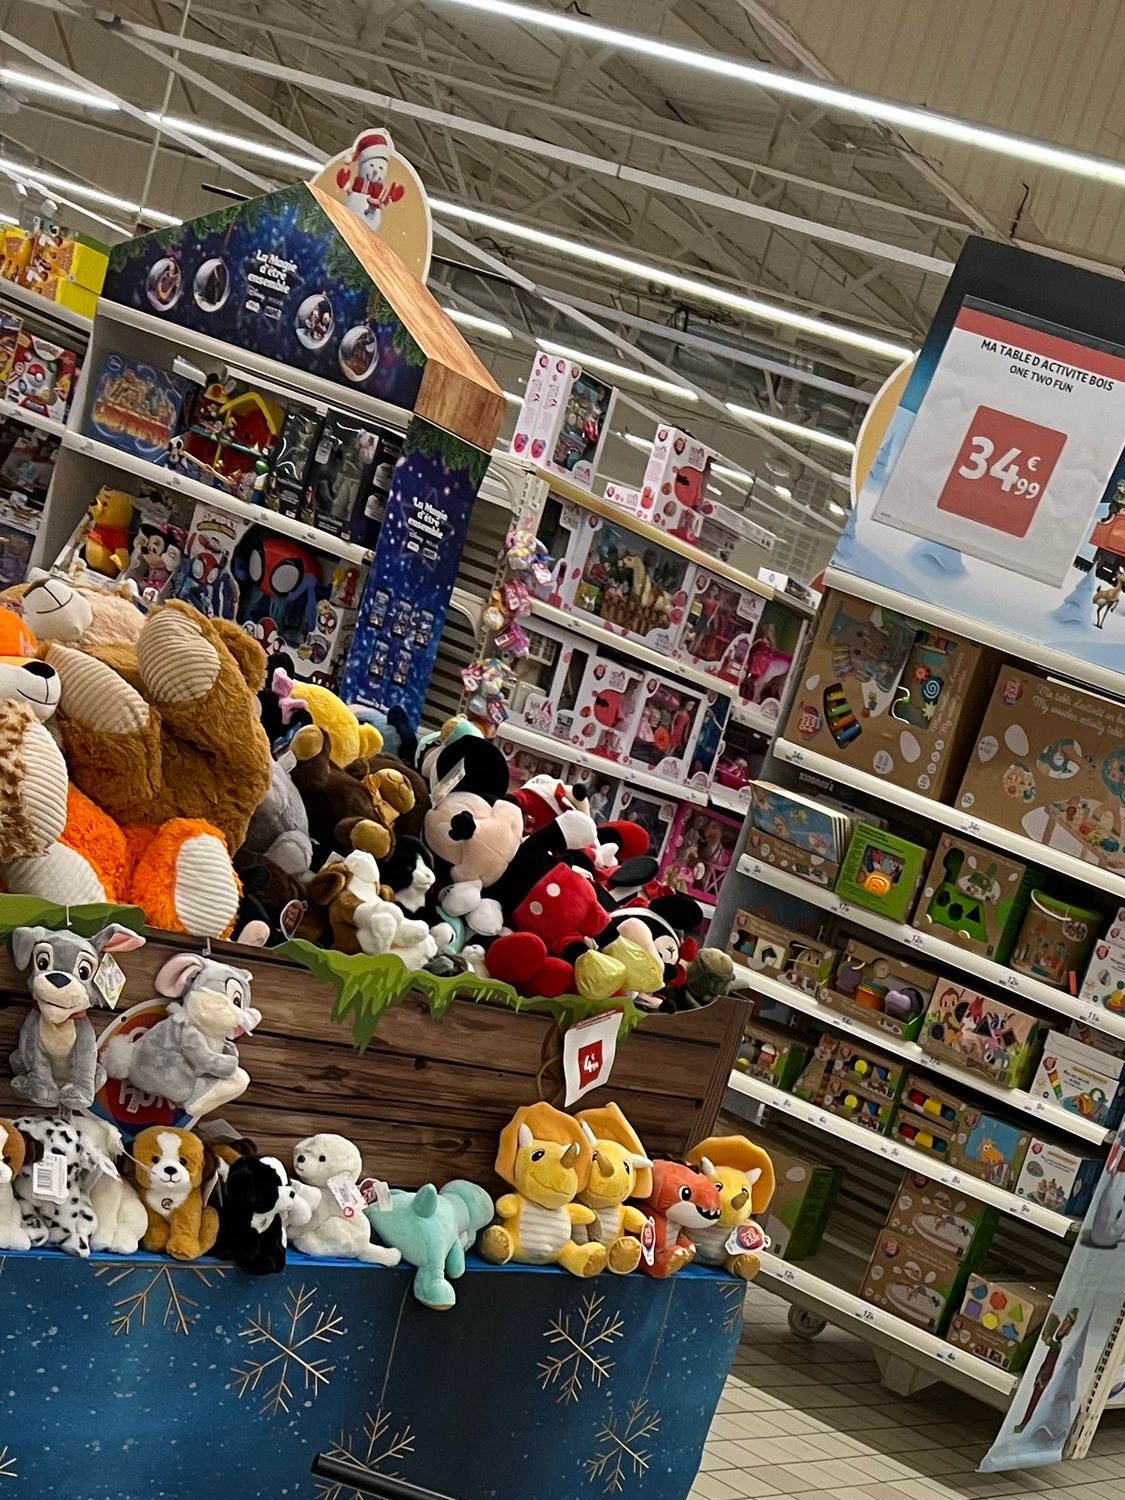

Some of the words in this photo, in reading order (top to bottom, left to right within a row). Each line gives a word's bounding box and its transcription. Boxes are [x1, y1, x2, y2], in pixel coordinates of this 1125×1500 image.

[981, 340, 997, 352] MA
[1000, 345, 1031, 366] TABLE
[1031, 356, 1040, 366] D
[1041, 360, 1089, 383] ACTIVITE
[1089, 376, 1114, 391] BOIS
[1009, 365, 1029, 378] ONE
[1031, 372, 1053, 386] TWO
[1053, 380, 1074, 393] FUN
